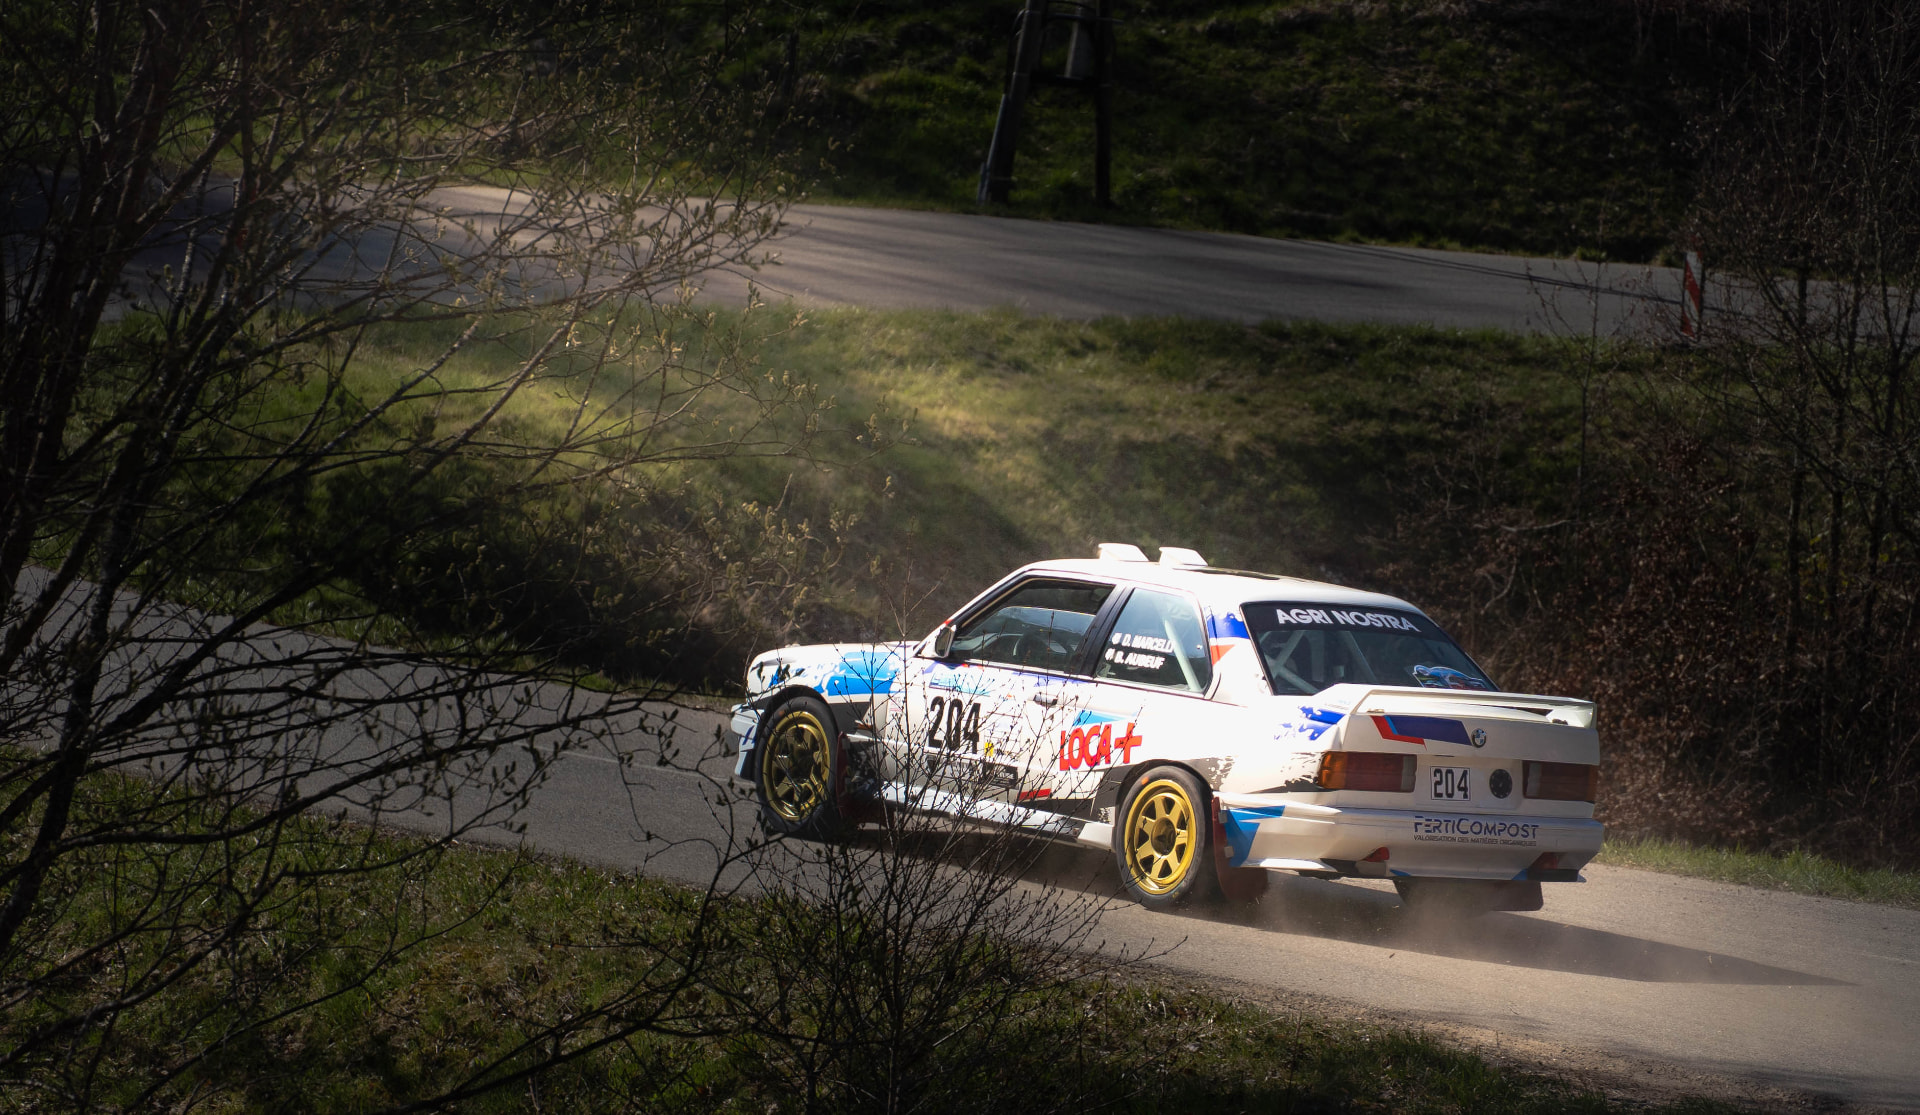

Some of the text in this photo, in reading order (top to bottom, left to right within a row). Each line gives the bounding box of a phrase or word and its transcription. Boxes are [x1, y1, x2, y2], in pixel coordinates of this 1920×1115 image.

[1276, 608, 1422, 632] AGRI NOSTRA
[928, 695, 981, 754] 204
[1433, 769, 1469, 799] 204
